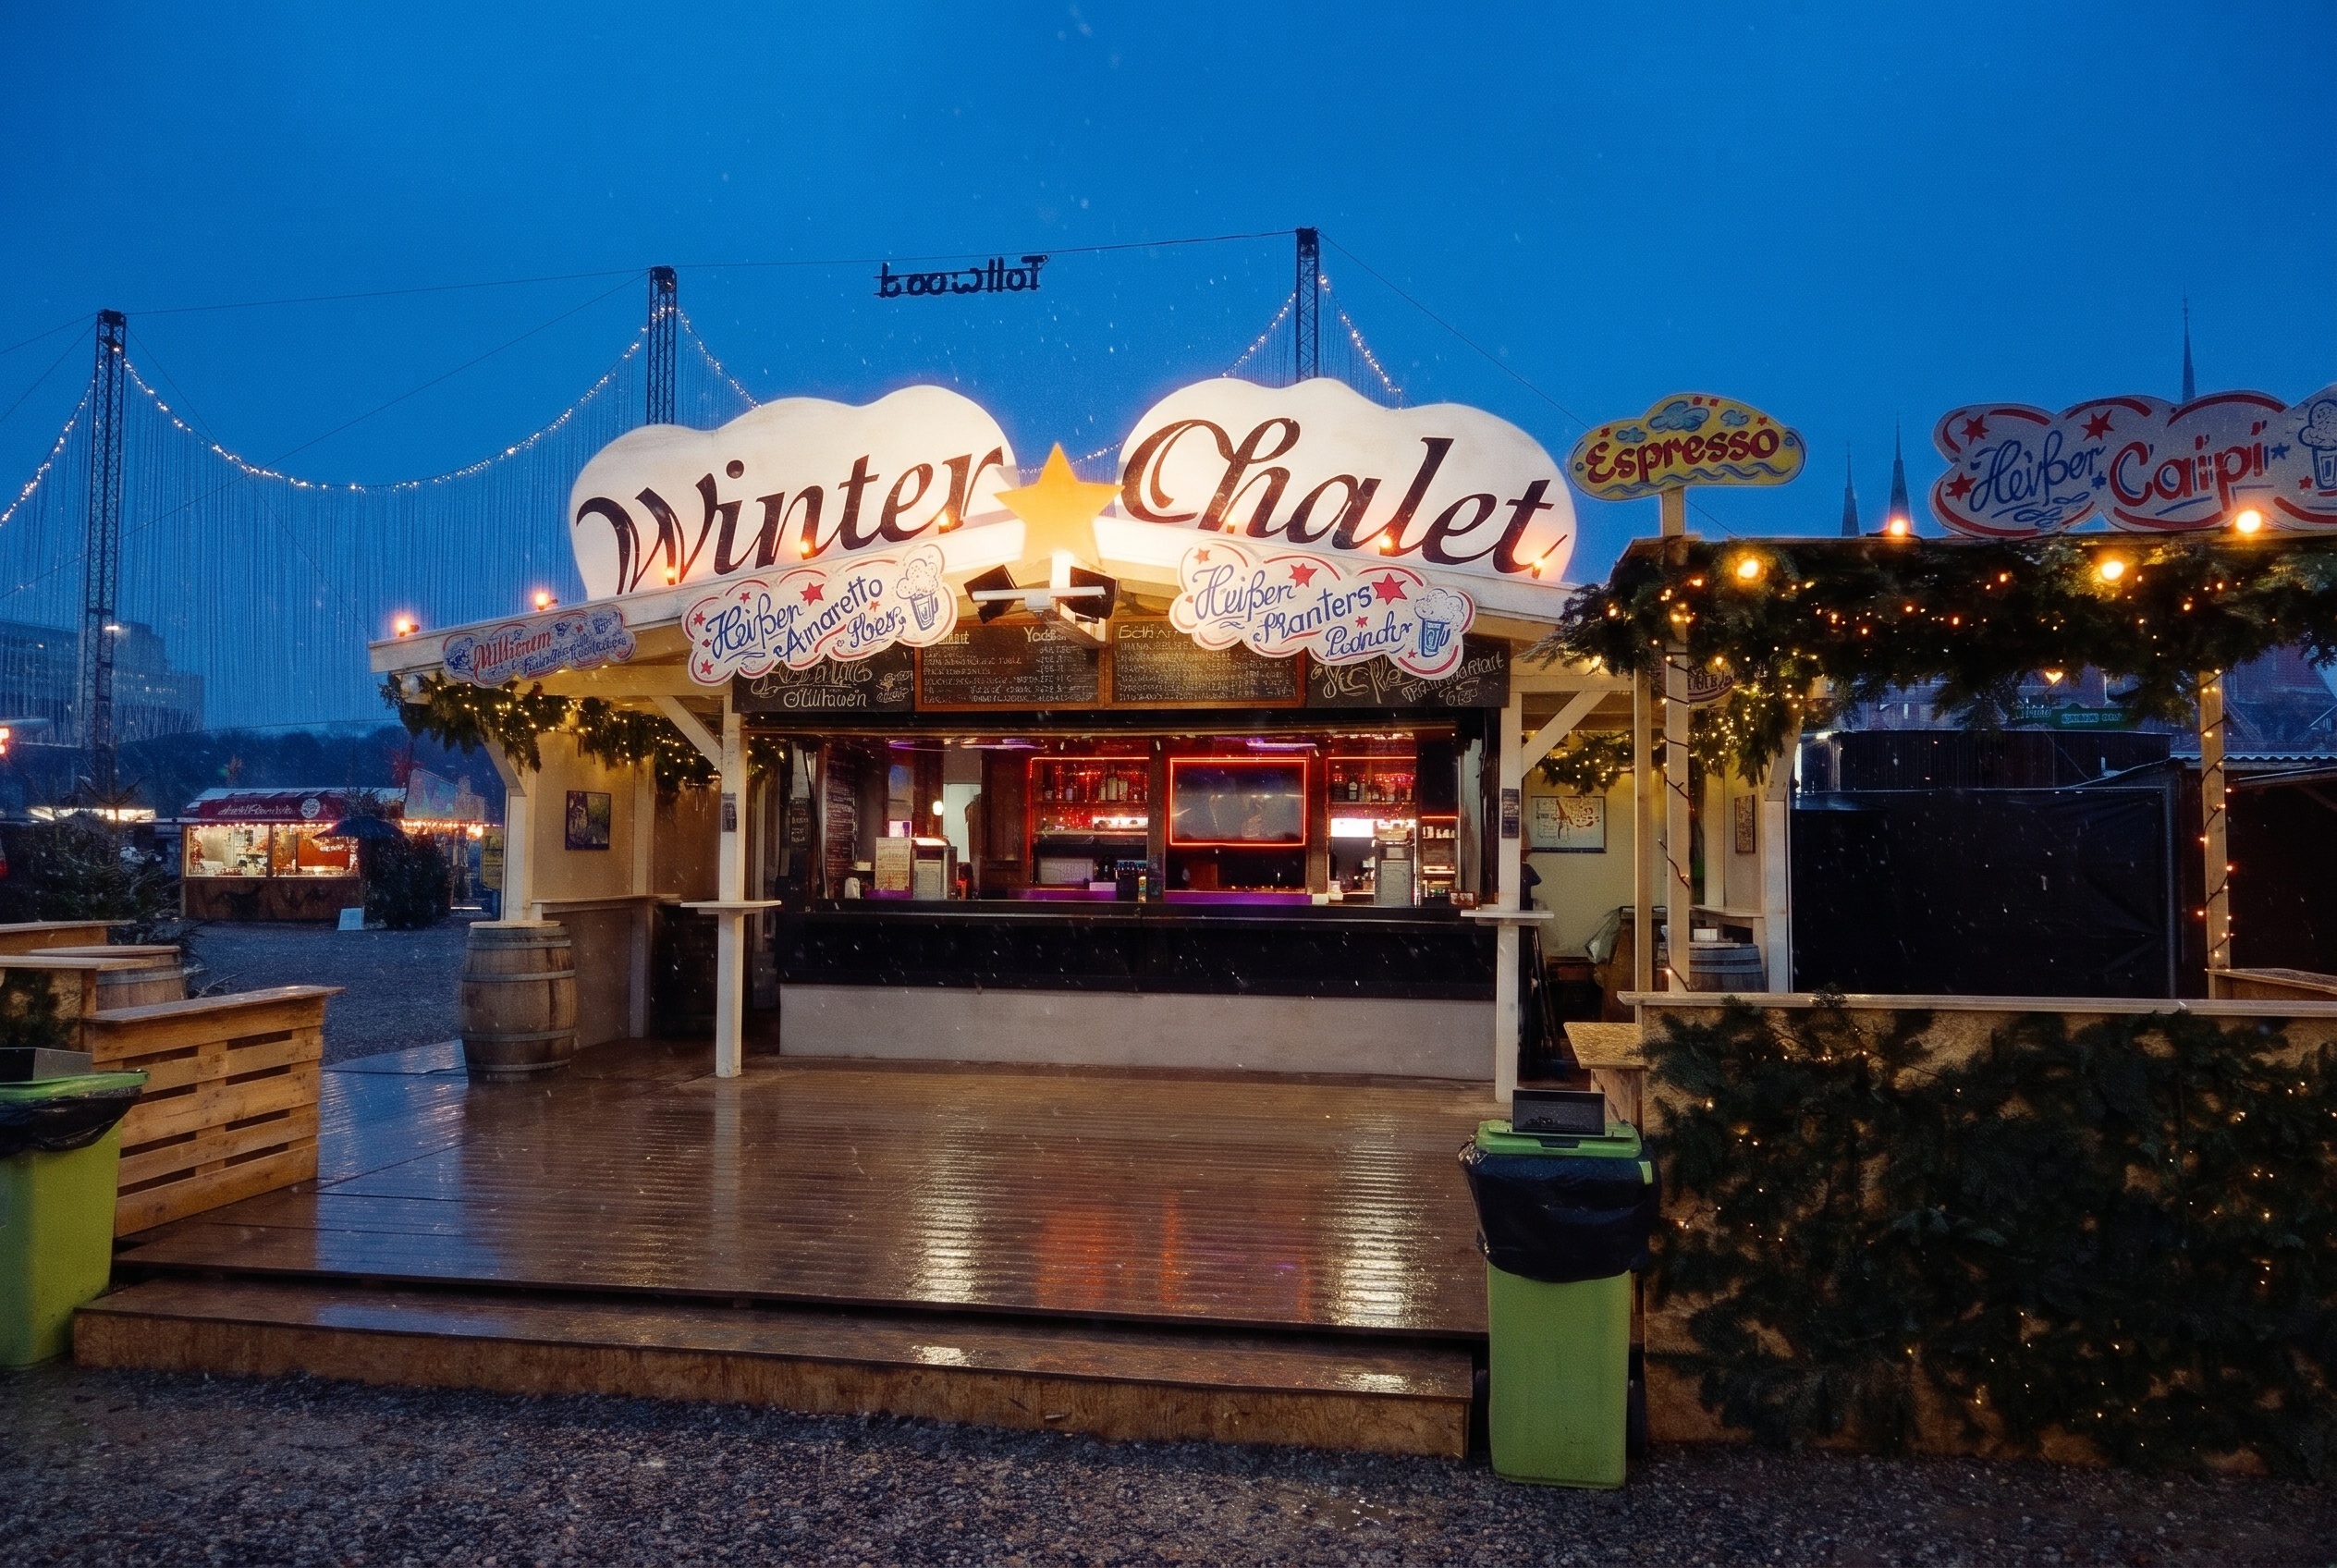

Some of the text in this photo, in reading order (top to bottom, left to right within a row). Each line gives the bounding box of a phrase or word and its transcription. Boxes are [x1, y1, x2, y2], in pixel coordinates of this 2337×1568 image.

[1585, 427, 1780, 484] Espresso
[1968, 421, 2269, 512] Heißer Caipi
[576, 417, 1569, 595] Winter Chalet
[773, 575, 883, 662] Amaretto
[1254, 585, 1373, 643] Planters
